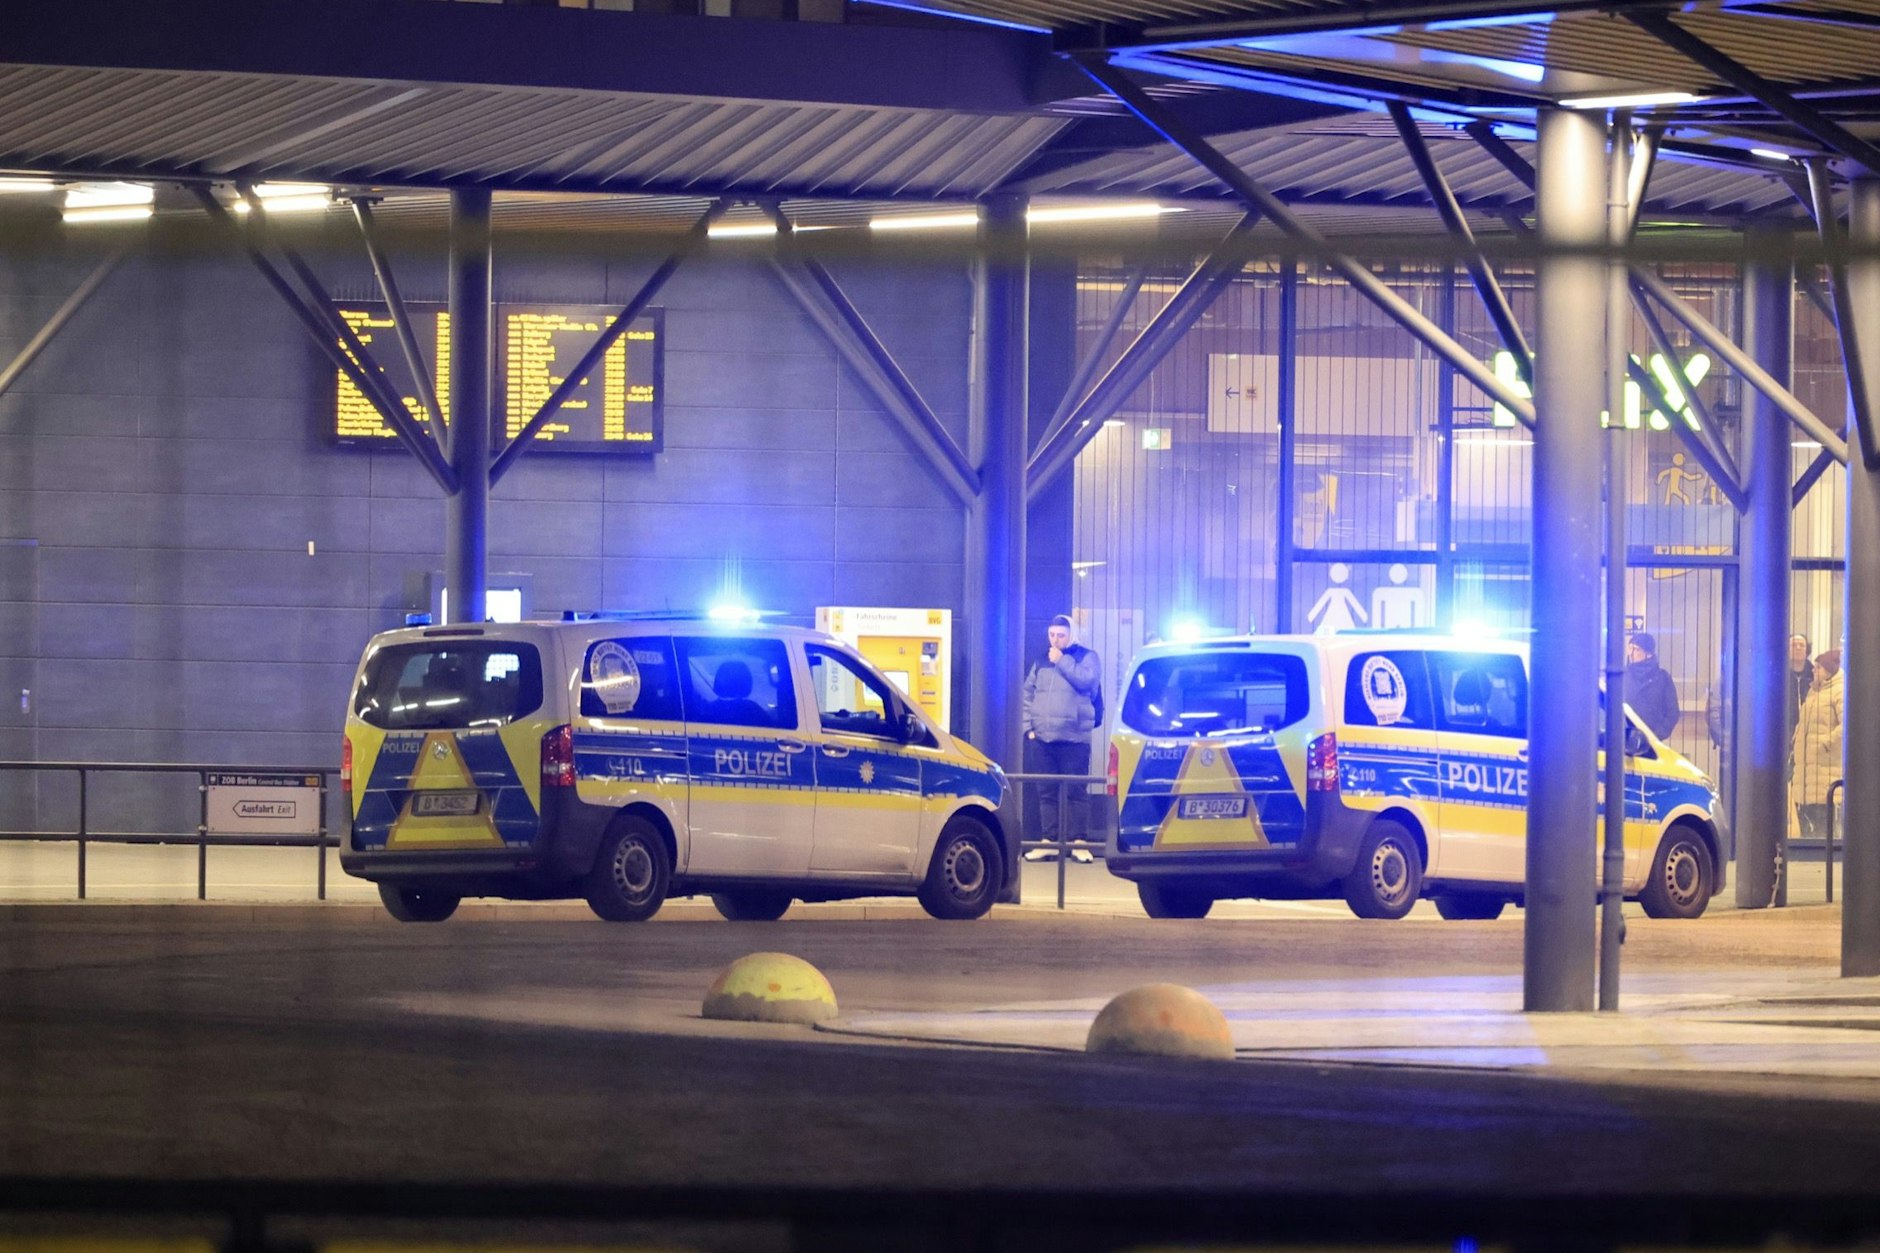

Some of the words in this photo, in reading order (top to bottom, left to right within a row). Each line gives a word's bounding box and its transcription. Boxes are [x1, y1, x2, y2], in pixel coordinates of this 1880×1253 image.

[383, 743, 420, 754] POLIZEI
[1145, 750, 1183, 760] POLIZEI
[714, 749, 792, 776] POLIZEI
[221, 776, 236, 785] ZOB
[237, 776, 257, 785] Berlin
[1359, 768, 1376, 782] 110
[1448, 763, 1528, 796] POLIZE
[241, 804, 274, 814] Ausfahrt
[277, 805, 291, 814] Exit
